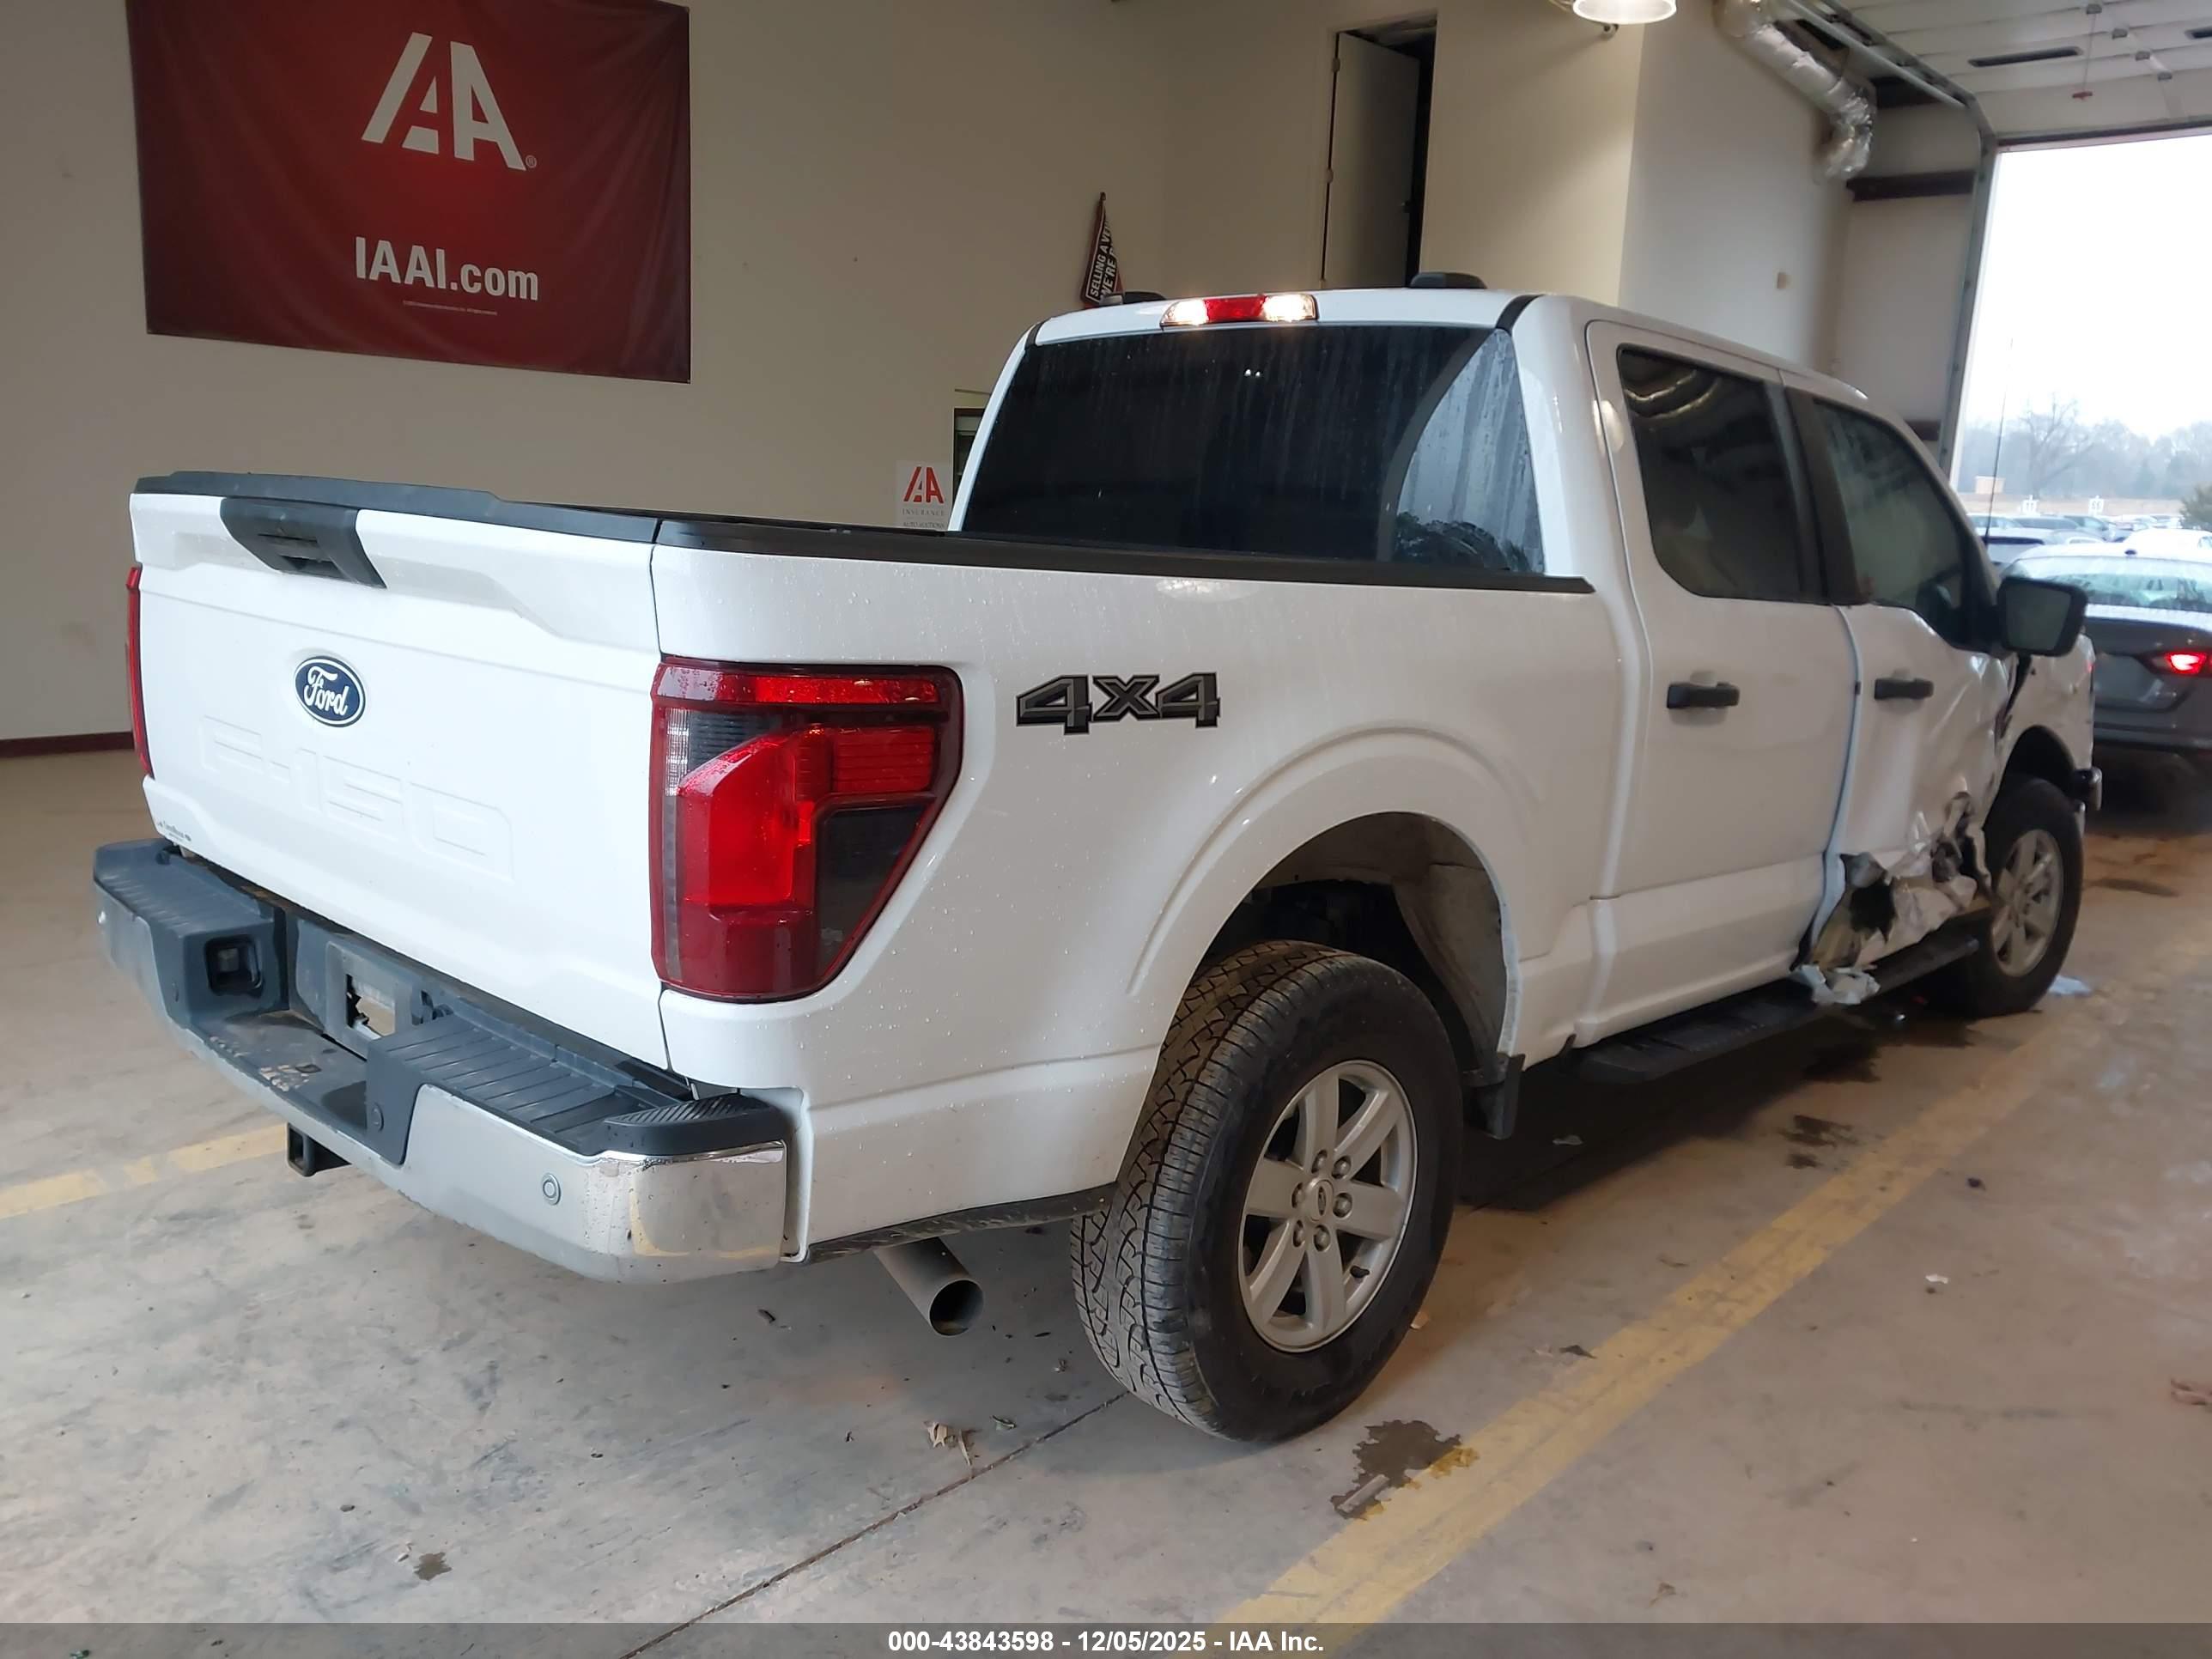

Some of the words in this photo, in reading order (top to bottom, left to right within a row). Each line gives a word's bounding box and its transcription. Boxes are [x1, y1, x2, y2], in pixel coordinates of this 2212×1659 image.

[356, 236, 538, 301] IAAI.com
[1090, 254, 1107, 297] SELLING
[303, 665, 350, 716] Ford
